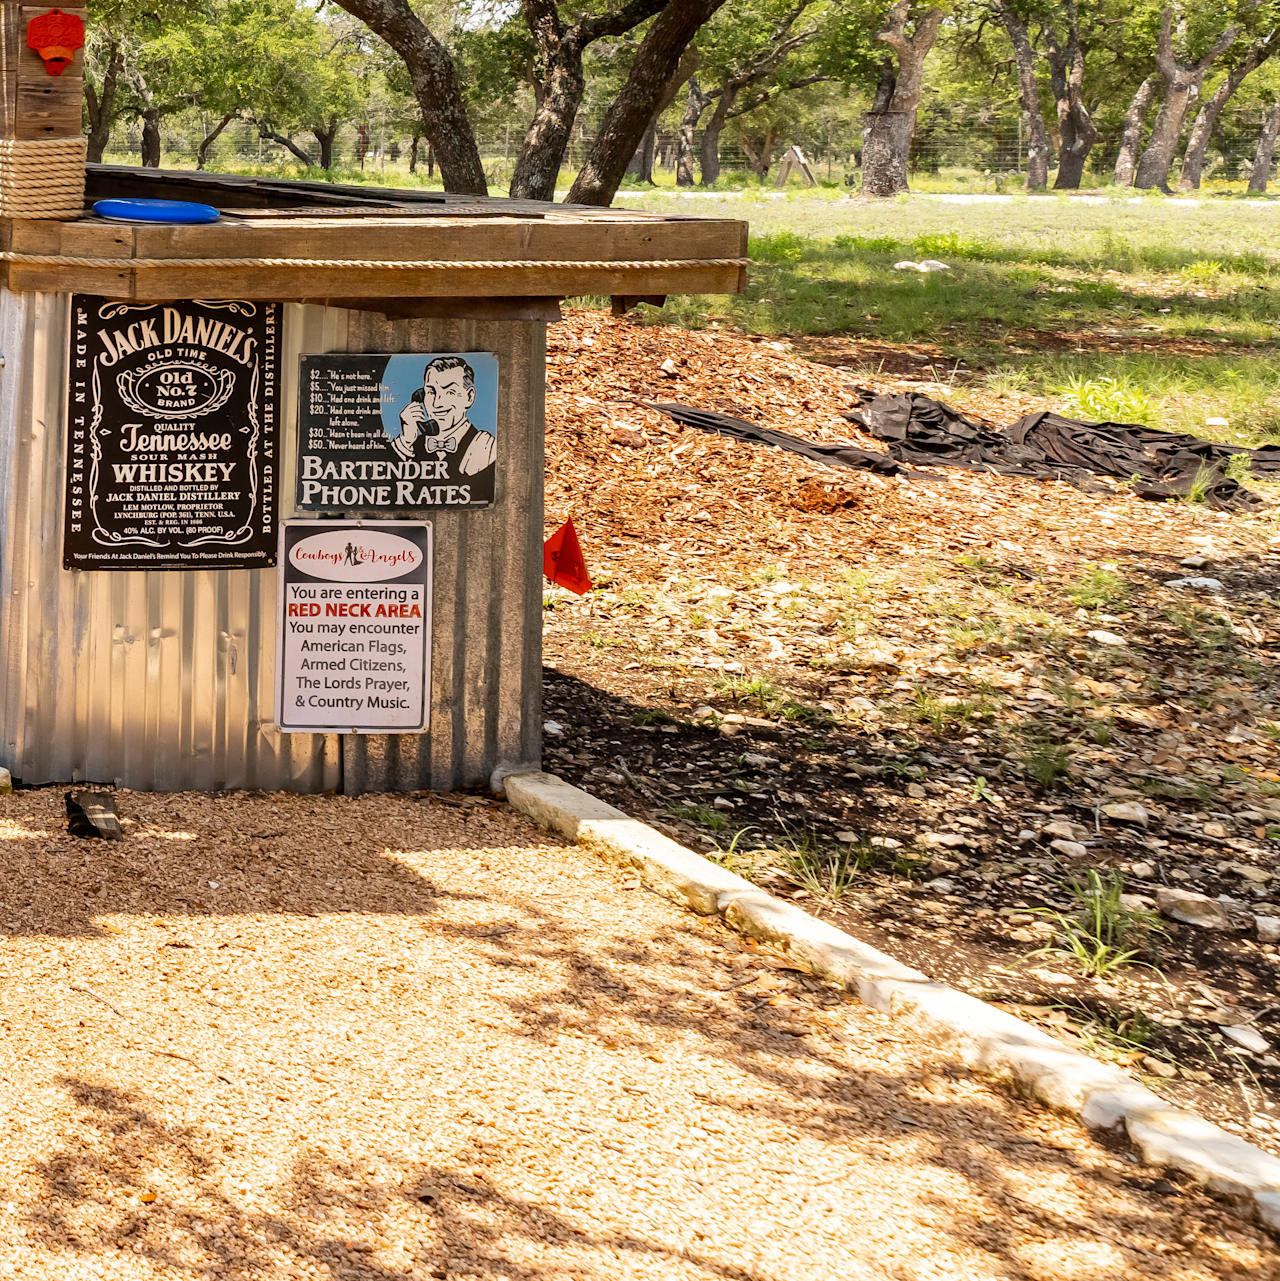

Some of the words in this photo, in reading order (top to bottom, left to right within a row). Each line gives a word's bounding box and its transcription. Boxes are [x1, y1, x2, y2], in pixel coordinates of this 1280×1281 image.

[75, 312, 88, 369] MADE
[97, 318, 162, 367] JACK
[163, 307, 259, 367] DANIEL'S
[147, 348, 173, 361] OLD
[177, 347, 207, 361] TIME
[160, 372, 193, 384] Old
[75, 382, 86, 403] IN
[343, 384, 356, 394] just
[357, 383, 377, 391] missed
[157, 398, 196, 408] BRAND
[356, 394, 371, 403] drink
[264, 402, 274, 433] THE
[356, 406, 371, 415] drink
[154, 423, 196, 433] QUALITY
[329, 416, 341, 426] left
[119, 423, 232, 452] Tennessee
[351, 429, 365, 438] been
[263, 440, 273, 458] AT
[348, 441, 365, 449] heard
[366, 440, 374, 449] of
[130, 453, 169, 461] SOUR
[177, 453, 218, 461] MASH
[71, 416, 85, 533] TENNESSEE
[111, 462, 237, 483] WHISKEY
[106, 493, 134, 502] JACK
[136, 493, 177, 501] DANIEL
[179, 491, 241, 501] DISTILLERY
[262, 464, 273, 534] BOTTLED
[168, 526, 184, 534] VOL.
[73, 552, 87, 560] Your
[295, 546, 343, 565] Cowboys
[360, 549, 415, 567] Angels
[291, 586, 316, 599] You
[320, 589, 342, 599] are
[346, 587, 407, 603] entering
[411, 589, 419, 600] a
[288, 603, 321, 617] RED
[325, 603, 372, 617] NECK
[375, 604, 422, 618] AREA
[289, 621, 313, 633] You
[317, 624, 346, 636] may
[349, 623, 420, 634] encounter
[301, 640, 364, 652] American
[369, 640, 407, 655] Flags,
[301, 658, 346, 670] Armed
[349, 658, 406, 673] Citizens,
[296, 676, 321, 689] The
[324, 676, 361, 689] Lords
[365, 677, 410, 693] Prayer,
[295, 695, 305, 707] &
[308, 695, 364, 711] Country
[367, 696, 410, 709] Music.
